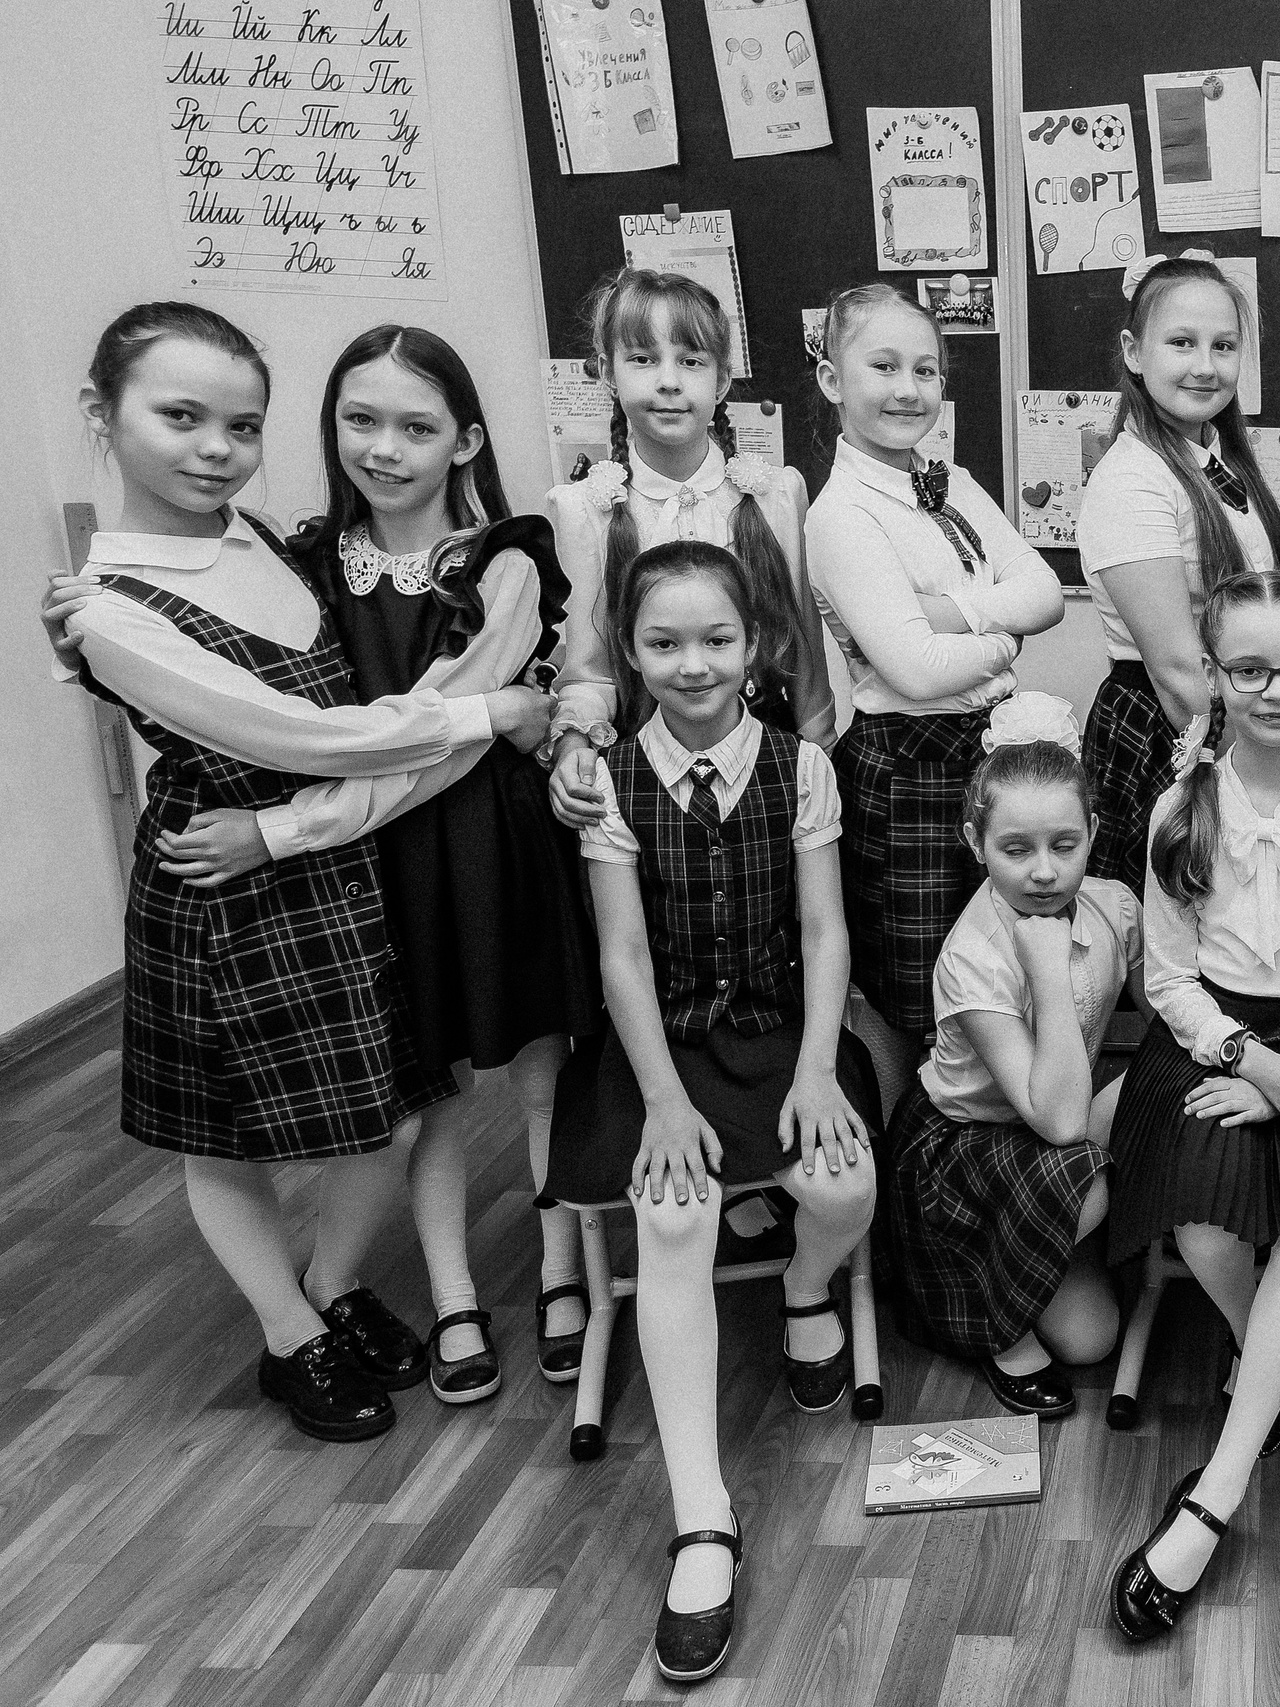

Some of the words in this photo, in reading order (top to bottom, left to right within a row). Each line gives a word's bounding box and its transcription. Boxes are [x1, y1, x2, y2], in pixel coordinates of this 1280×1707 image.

[165, 2, 204, 36] Ии
[232, 0, 272, 40] Йй
[298, 8, 338, 44] Кк
[361, 13, 408, 47] Лл
[166, 51, 230, 86] Мм
[248, 54, 292, 88] Нн
[311, 57, 345, 92] Оо
[363, 60, 413, 95] Пп
[603, 70, 612, 88] Б
[171, 97, 210, 144] Рр
[238, 101, 268, 134] Сс
[295, 105, 360, 139] Тт
[388, 109, 420, 155] Уу
[180, 145, 223, 190] Фф
[241, 147, 295, 182] Хх
[316, 151, 360, 192] Цц
[381, 154, 416, 188] Чч
[1035, 170, 1134, 205] СПОРТ
[188, 190, 245, 224] Шш
[262, 195, 326, 235] Щщ
[340, 213, 361, 231] ъ
[375, 215, 398, 232] ы
[411, 217, 426, 234] ь
[193, 236, 226, 268] Ээ
[284, 241, 336, 274] Юю
[391, 247, 431, 279] Яя
[944, 1436, 1002, 1467] Математика
